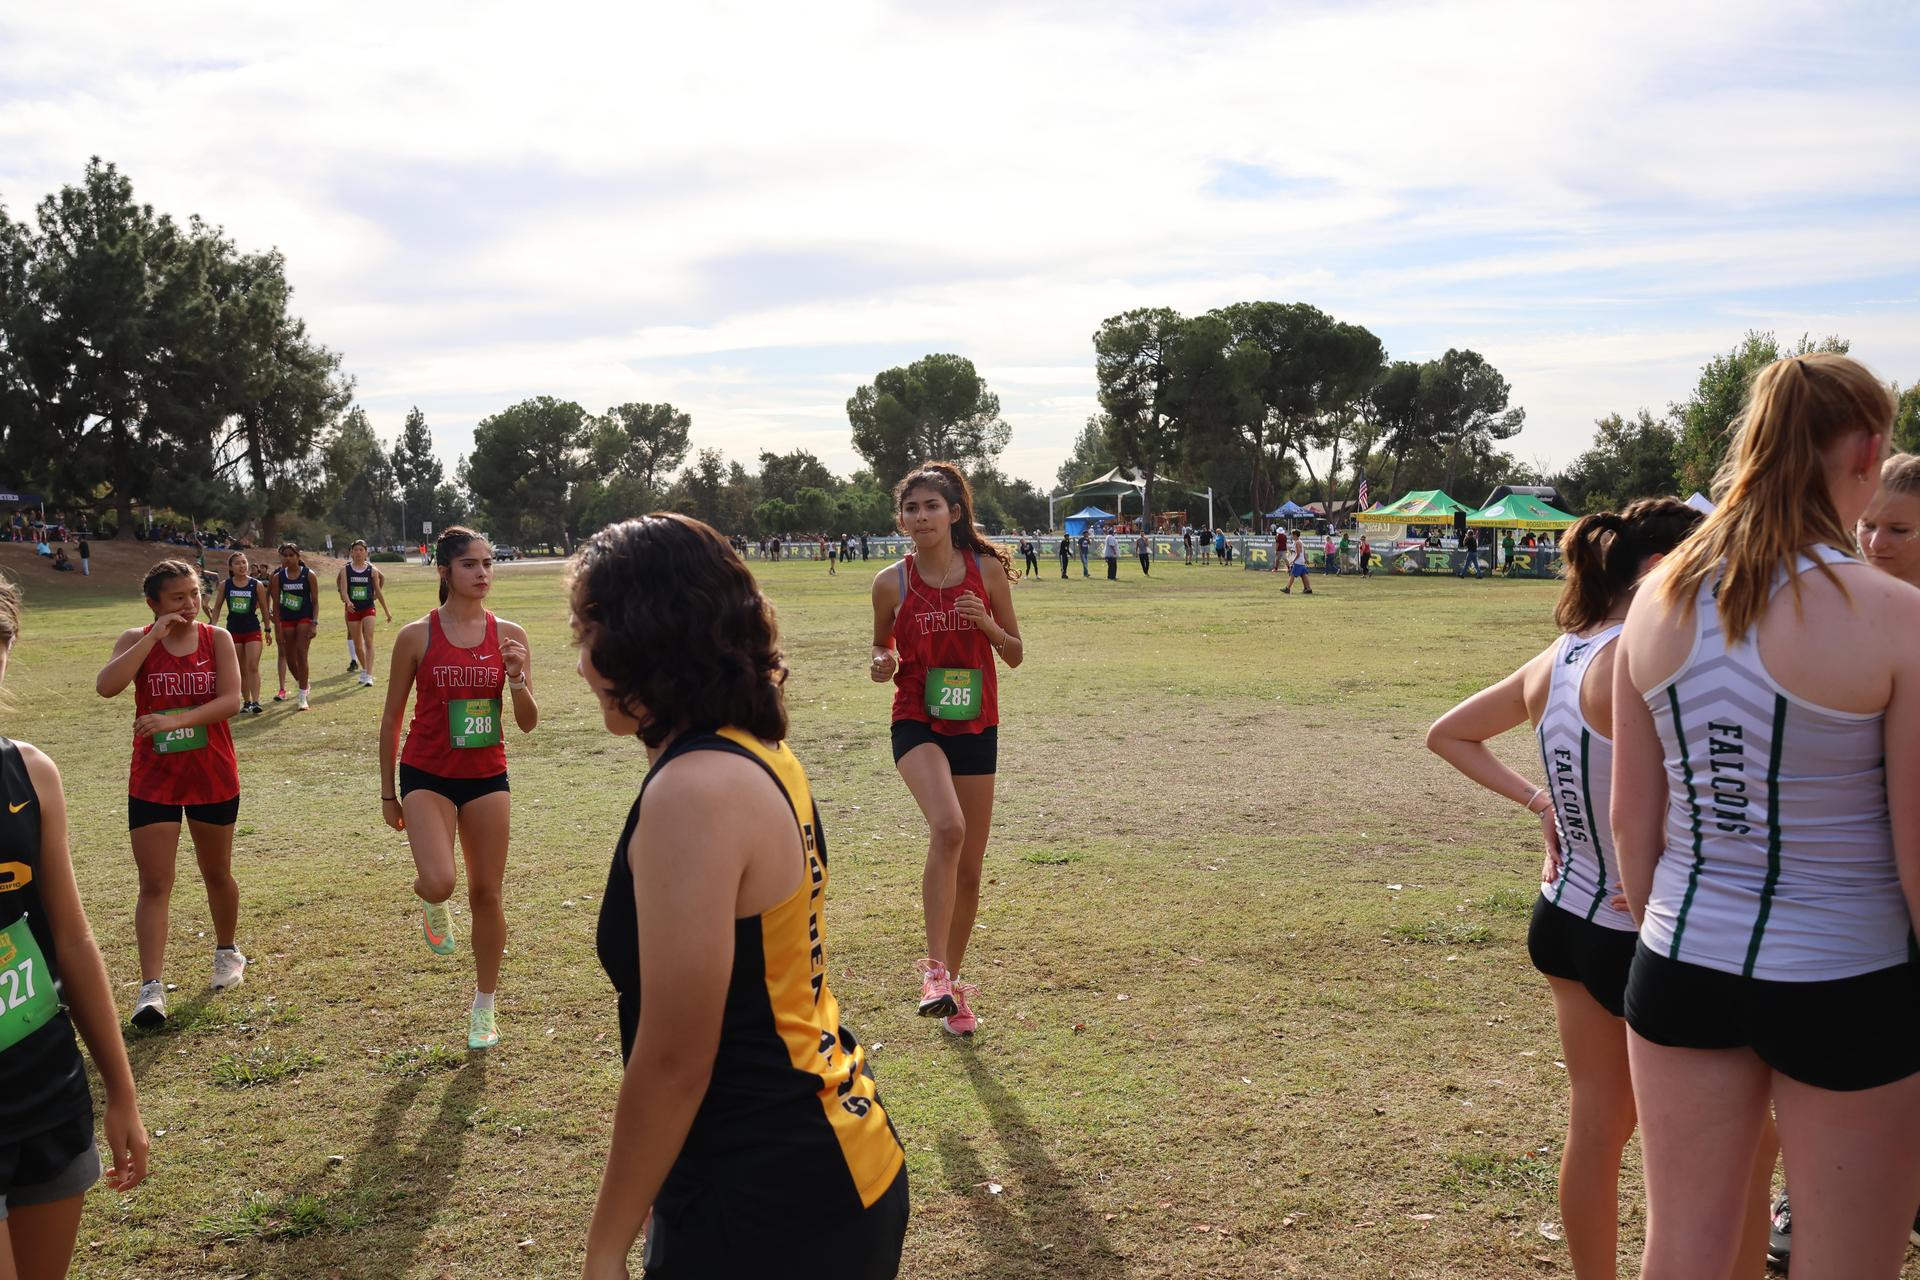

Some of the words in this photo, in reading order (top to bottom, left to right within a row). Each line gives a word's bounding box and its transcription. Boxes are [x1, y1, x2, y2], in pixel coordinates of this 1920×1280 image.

[915, 609, 977, 635] TRIB
[433, 665, 499, 688] TRIBE
[940, 687, 972, 706] 285
[464, 716, 492, 735] 288
[1708, 721, 1752, 834] FALCONS
[1554, 748, 1588, 843] FALCONS
[0, 957, 36, 1017] 27
